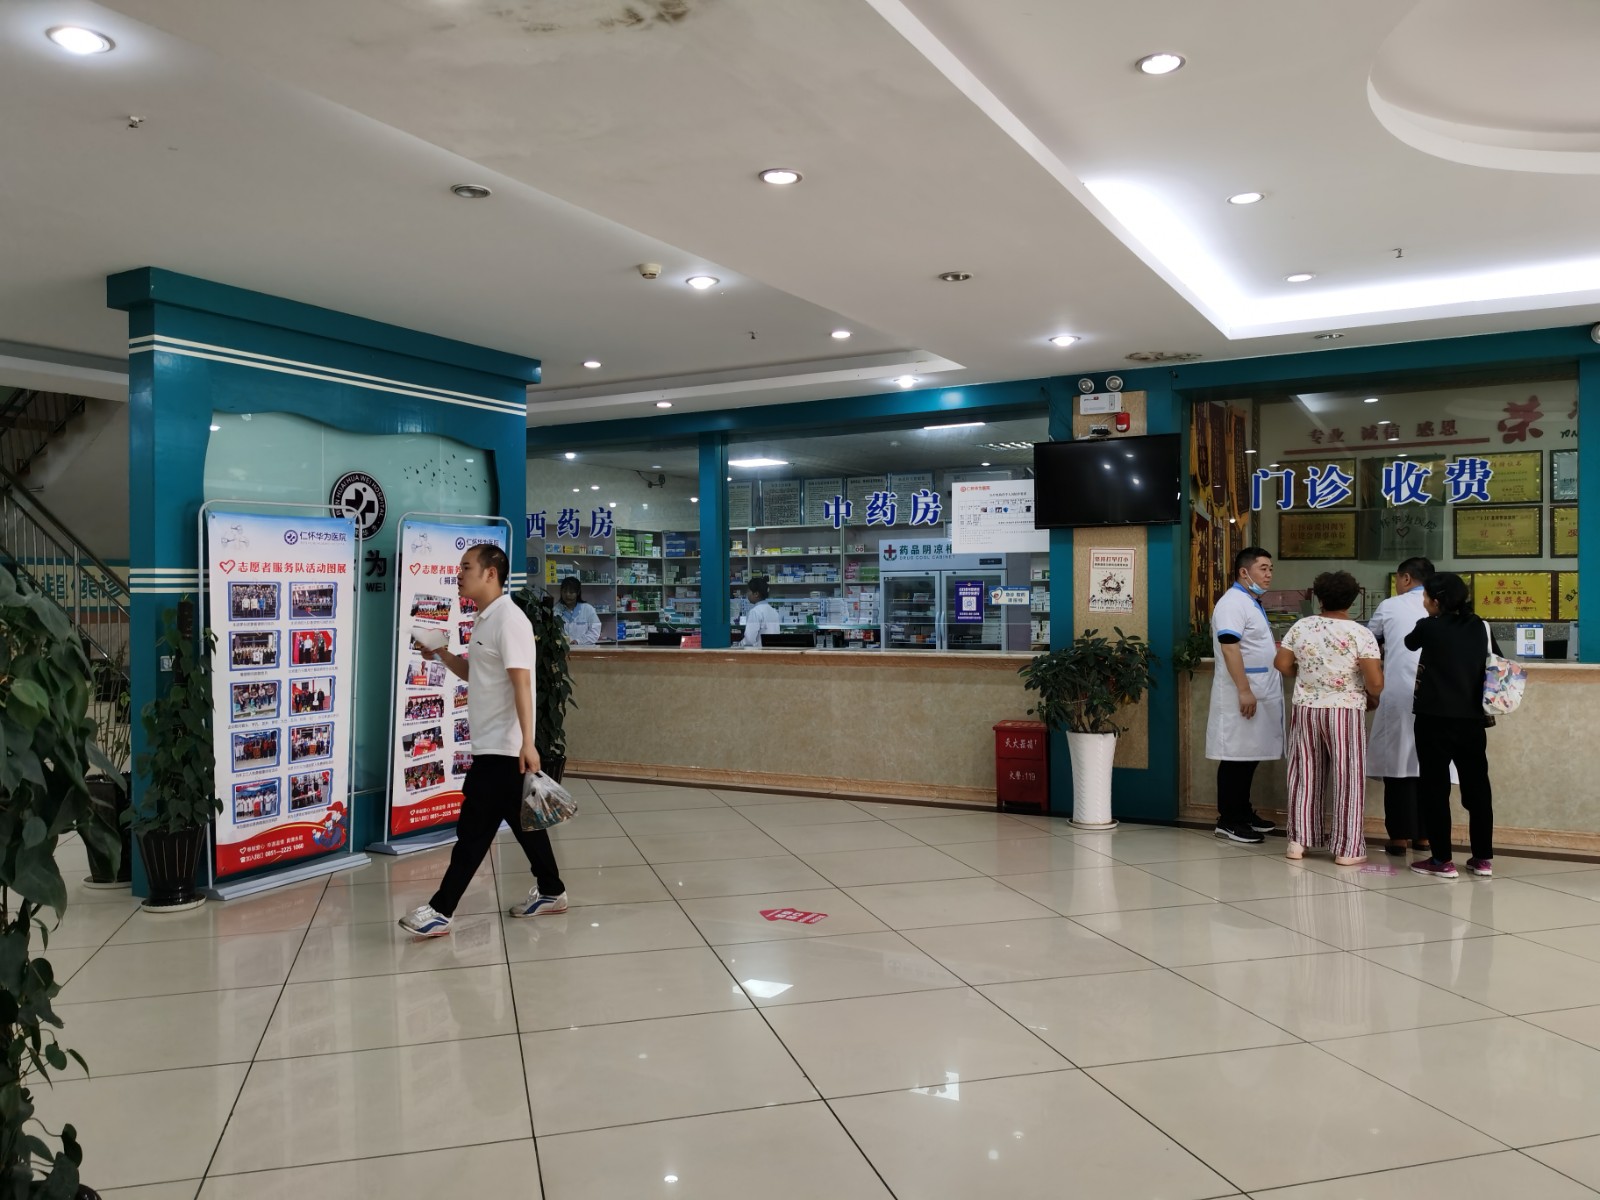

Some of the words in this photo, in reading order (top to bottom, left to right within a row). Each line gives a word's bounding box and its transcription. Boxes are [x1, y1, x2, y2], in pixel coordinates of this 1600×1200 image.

[1308, 428, 1345, 444] 专业
[1361, 422, 1401, 440] 诚信
[1416, 419, 1457, 438] 感恩
[1252, 464, 1354, 511] 门诊
[1382, 458, 1493, 505] 收费
[371, 481, 385, 517] HOSPITAL
[823, 489, 942, 529] 中药房
[526, 507, 614, 539] 西药房
[300, 531, 347, 542] 仁怀华为医院
[238, 561, 347, 575] 志愿者服务队活动图展
[365, 550, 387, 578] 为
[422, 565, 462, 575] 志愿者服务
[365, 582, 387, 593] WEI
[1482, 595, 1536, 605] 志愿服务队
